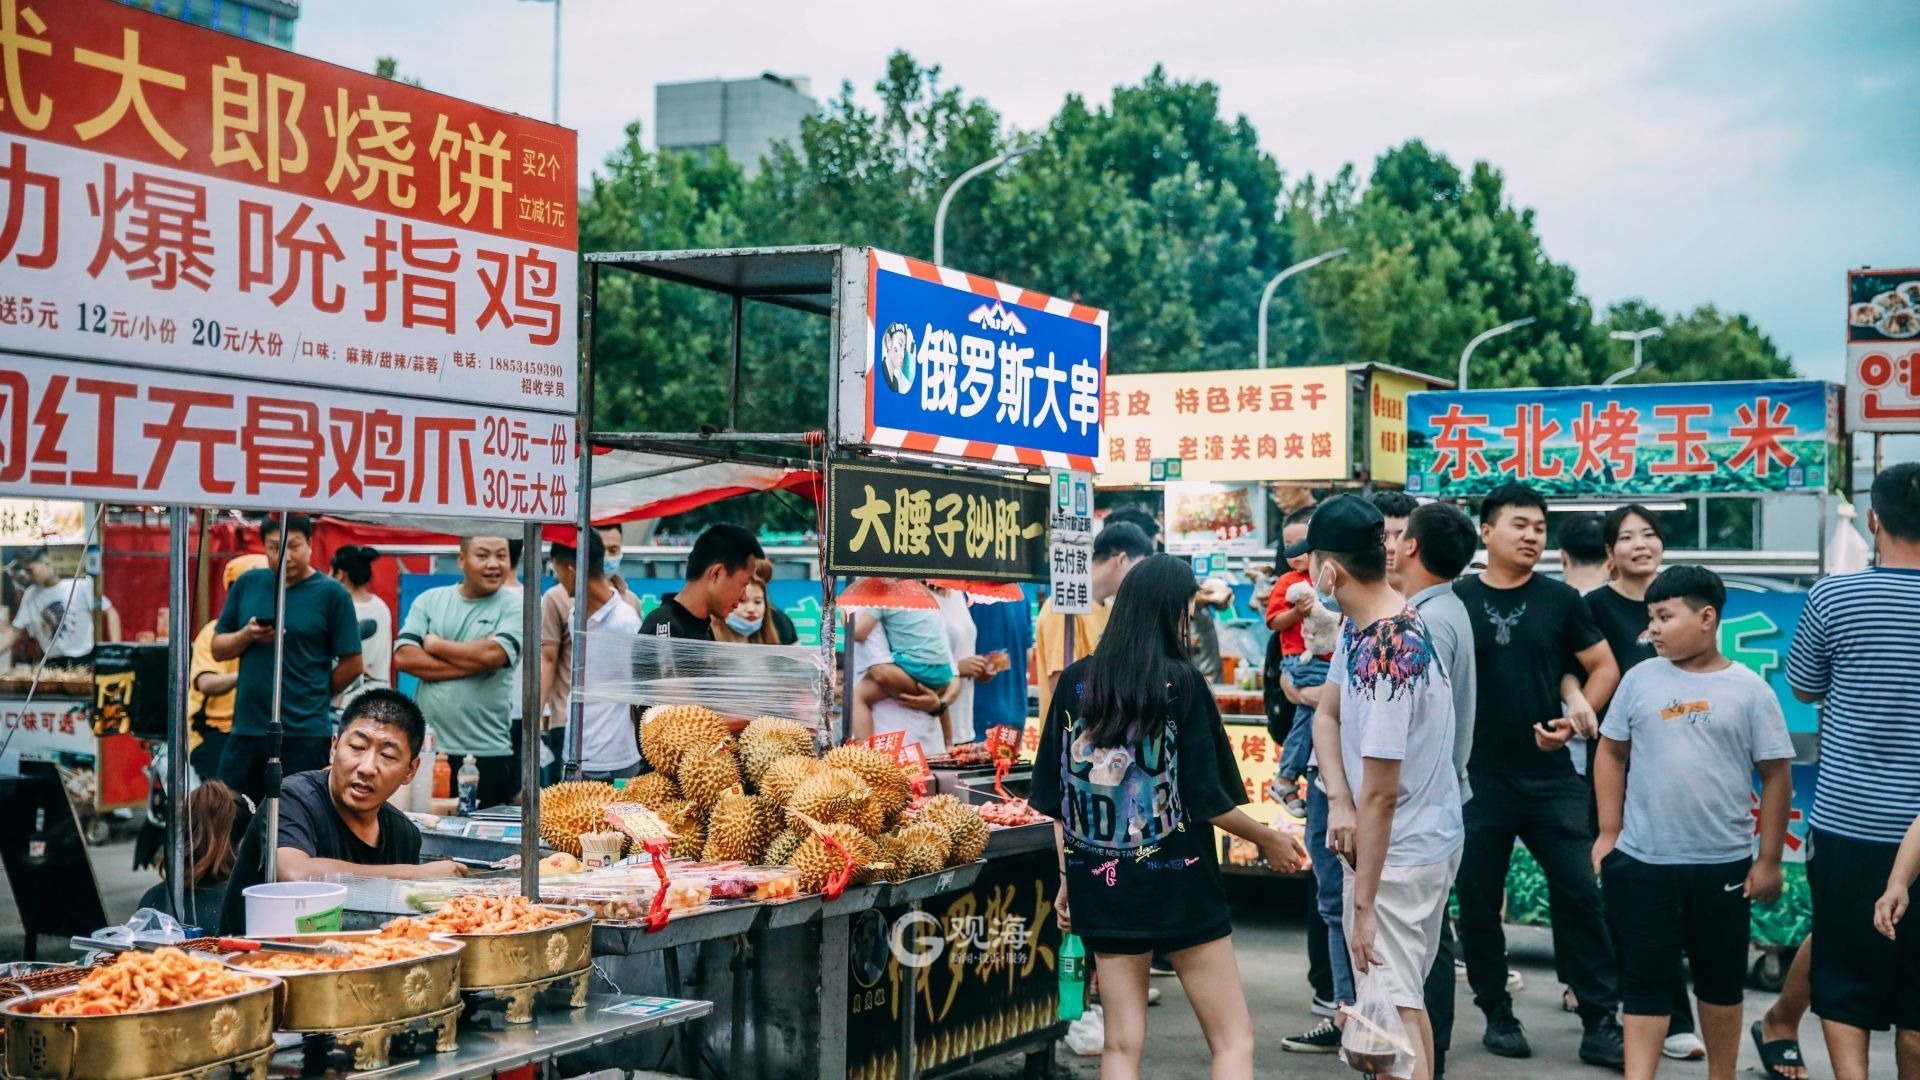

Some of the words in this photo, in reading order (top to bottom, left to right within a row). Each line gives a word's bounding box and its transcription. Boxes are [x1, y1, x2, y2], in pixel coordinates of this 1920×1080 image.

[523, 148, 560, 182] 买2个
[519, 194, 565, 228] 立减1元
[77, 302, 176, 344] 12元/小份
[192, 318, 283, 356] 20元/大份
[521, 378, 565, 398] 招收学员
[917, 322, 1100, 437] 俄罗斯大串
[1175, 383, 1327, 415] 特色烤豆干
[0, 369, 478, 506] 红无骨鸡爪
[483, 415, 567, 465] 20元一份
[1179, 432, 1332, 461] 老潼关肉夹馍
[1428, 397, 1798, 481] 东北烤玉米
[483, 468, 567, 516] 30元大份
[850, 484, 1048, 562] 大腰子沙肝一
[1054, 546, 1088, 575] 先付款
[1054, 581, 1088, 607] 后点单
